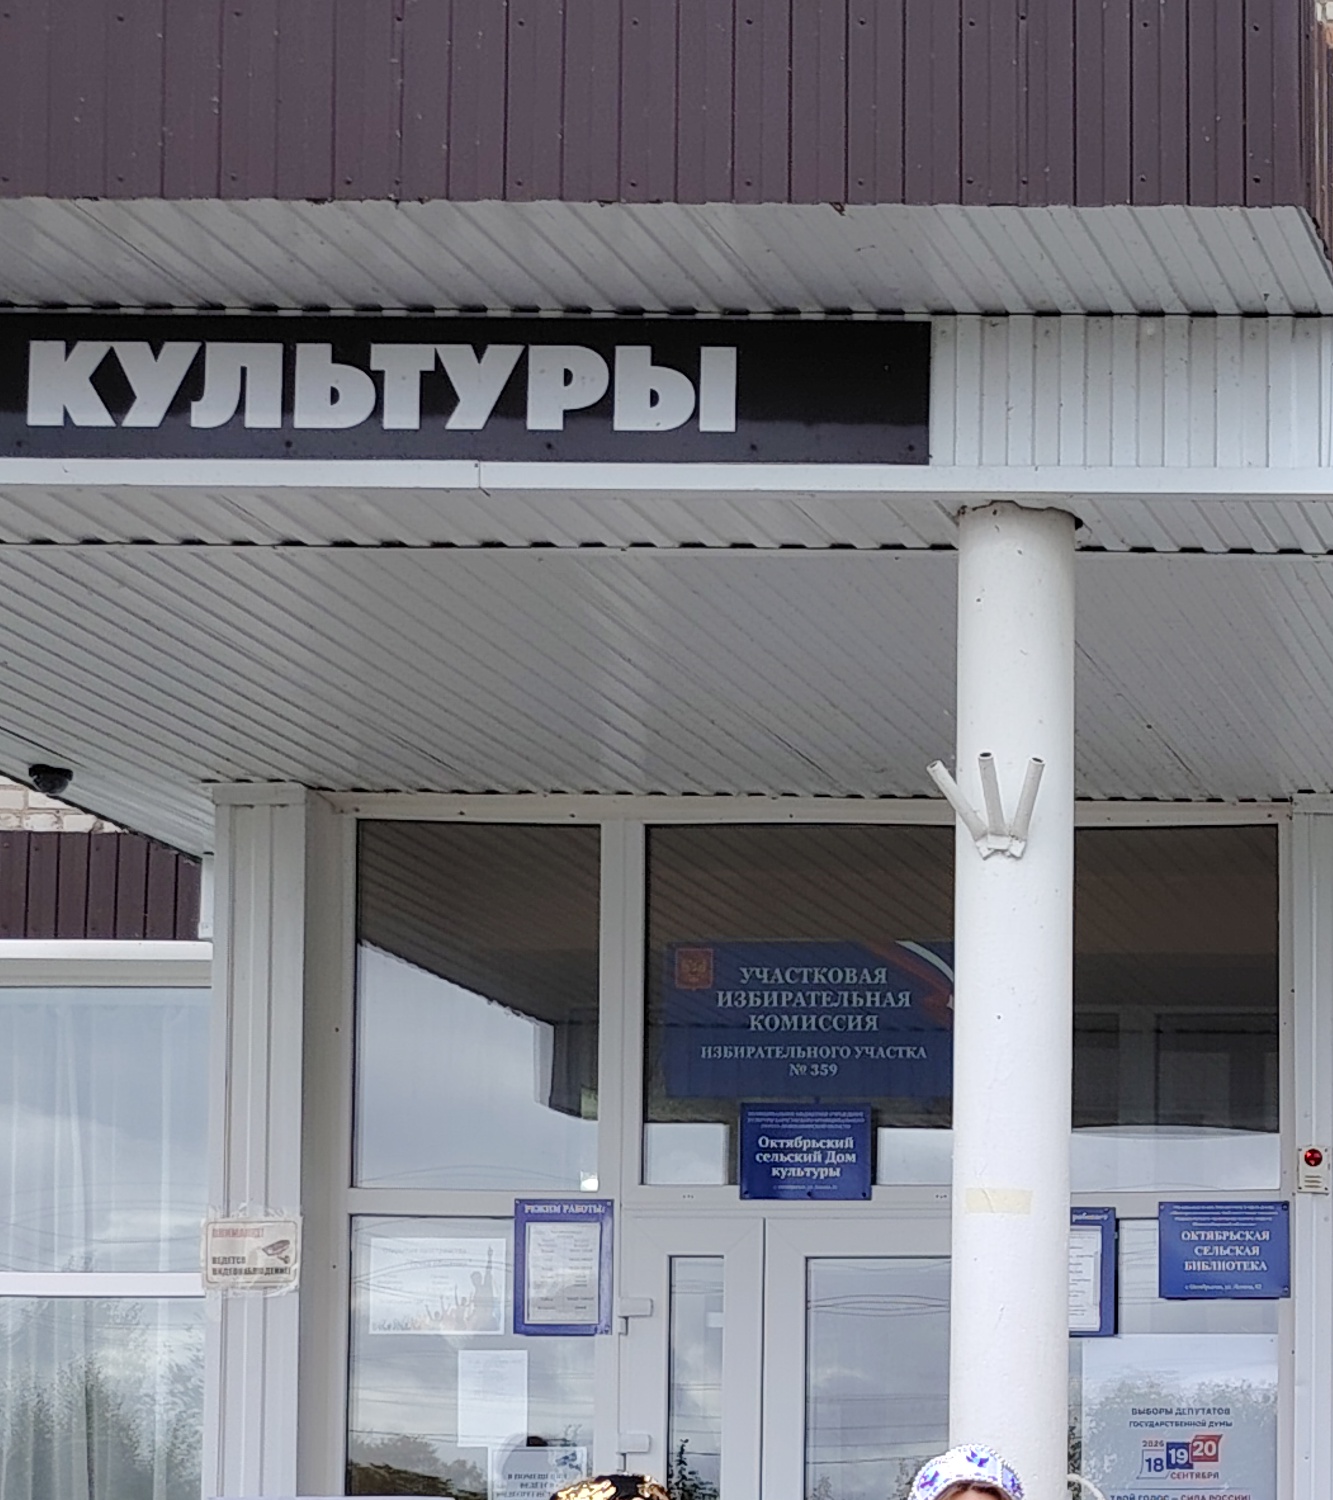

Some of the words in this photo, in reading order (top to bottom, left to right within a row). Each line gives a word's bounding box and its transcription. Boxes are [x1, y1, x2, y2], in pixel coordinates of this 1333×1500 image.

[26, 340, 738, 433] КУЛЬТУРЫ
[739, 967, 888, 985] УЧАСТКОВАЯ
[716, 990, 911, 1009] ИЗБИРАТЕЛЬНАЯ
[749, 1014, 879, 1032] КОМИССИЯ
[701, 1045, 850, 1060] ИЗБИРАТЕЛЬНОГО
[854, 1045, 928, 1060] УЧАСТКА
[789, 1063, 807, 1077] №
[810, 1063, 838, 1077] 359
[757, 1135, 854, 1151] Октябрьский
[755, 1150, 822, 1163] сельский
[825, 1151, 857, 1165] Дом
[771, 1167, 842, 1180] культуры
[1181, 1230, 1271, 1242] ОКТЯБРЬСКАЯ
[1194, 1245, 1260, 1257] СЕЛЬСКАЯ
[1184, 1260, 1268, 1272] БИБЛИОТЕКА
[1131, 1407, 1174, 1416] ВЫБОРЫ
[1175, 1407, 1231, 1416] ДЕПУТАТОВ
[1129, 1419, 1206, 1428] ГОСУДАРСТВЕННОЙ
[1207, 1420, 1233, 1428] ДУМЫ
[1141, 1440, 1165, 1448] 2026
[1144, 1457, 1165, 1473] 18
[1168, 1448, 1189, 1465] 19
[1192, 1440, 1217, 1457] 20
[1170, 1471, 1220, 1480] СЕНТЯБРЯ
